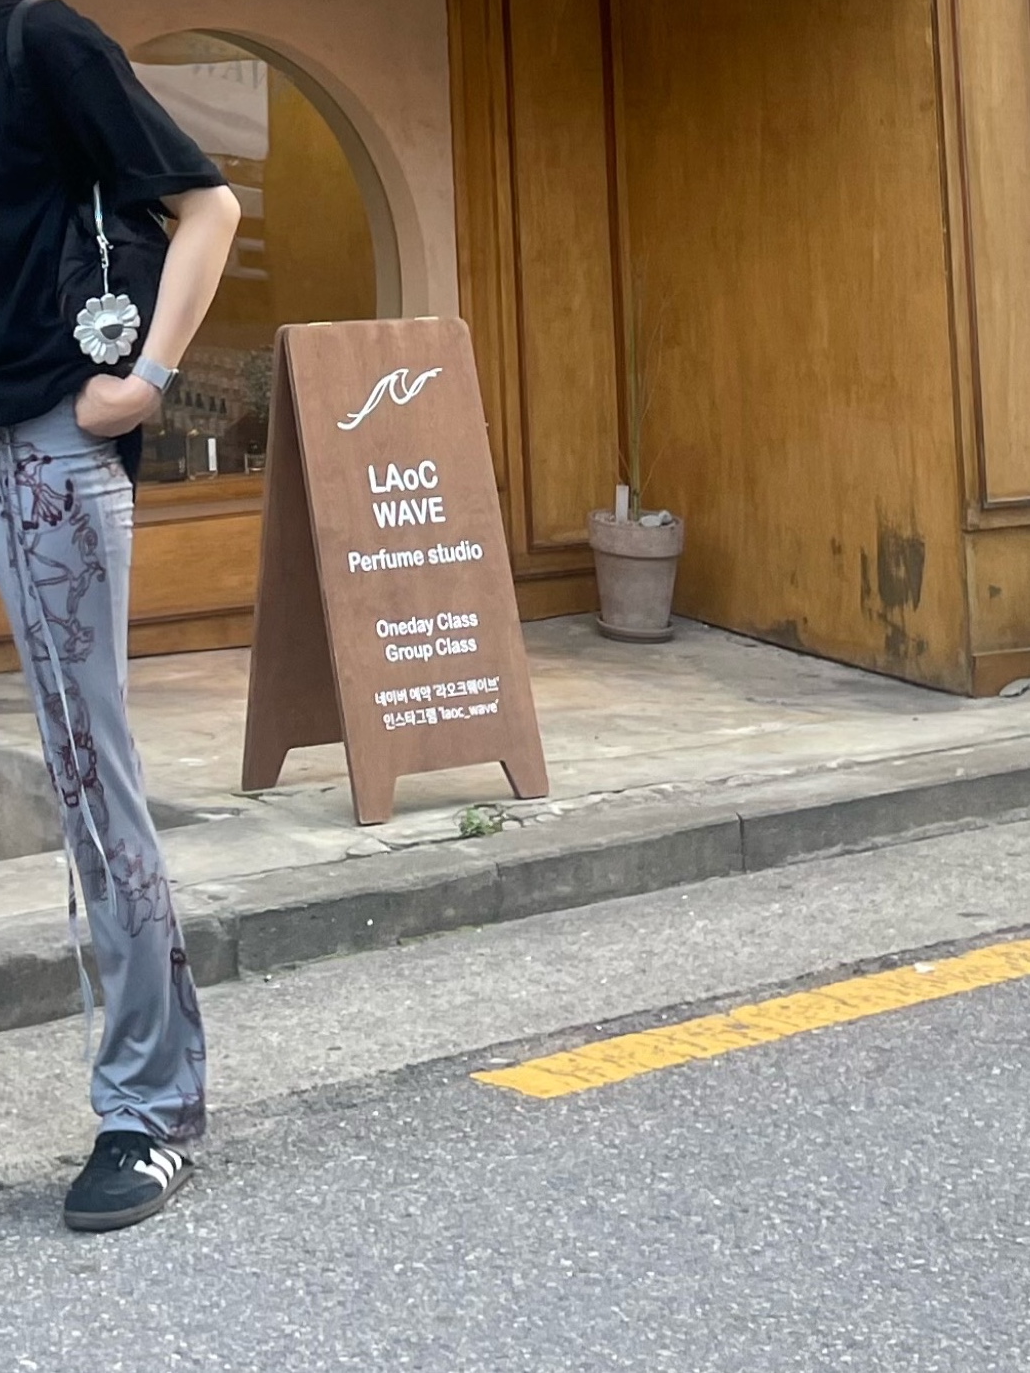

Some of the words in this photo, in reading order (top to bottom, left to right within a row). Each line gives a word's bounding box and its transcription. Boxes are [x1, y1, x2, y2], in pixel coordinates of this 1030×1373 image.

[368, 459, 438, 494] LAoC
[372, 496, 446, 529] WAVE
[347, 548, 425, 573] Perfume
[427, 540, 483, 565] studio
[376, 616, 434, 638] Oneday
[436, 612, 479, 631] Class
[385, 643, 433, 662] Group
[435, 637, 478, 656] Class
[374, 688, 409, 707] 네이버
[409, 685, 432, 702] 예약
[383, 706, 438, 731] 인스타그램
